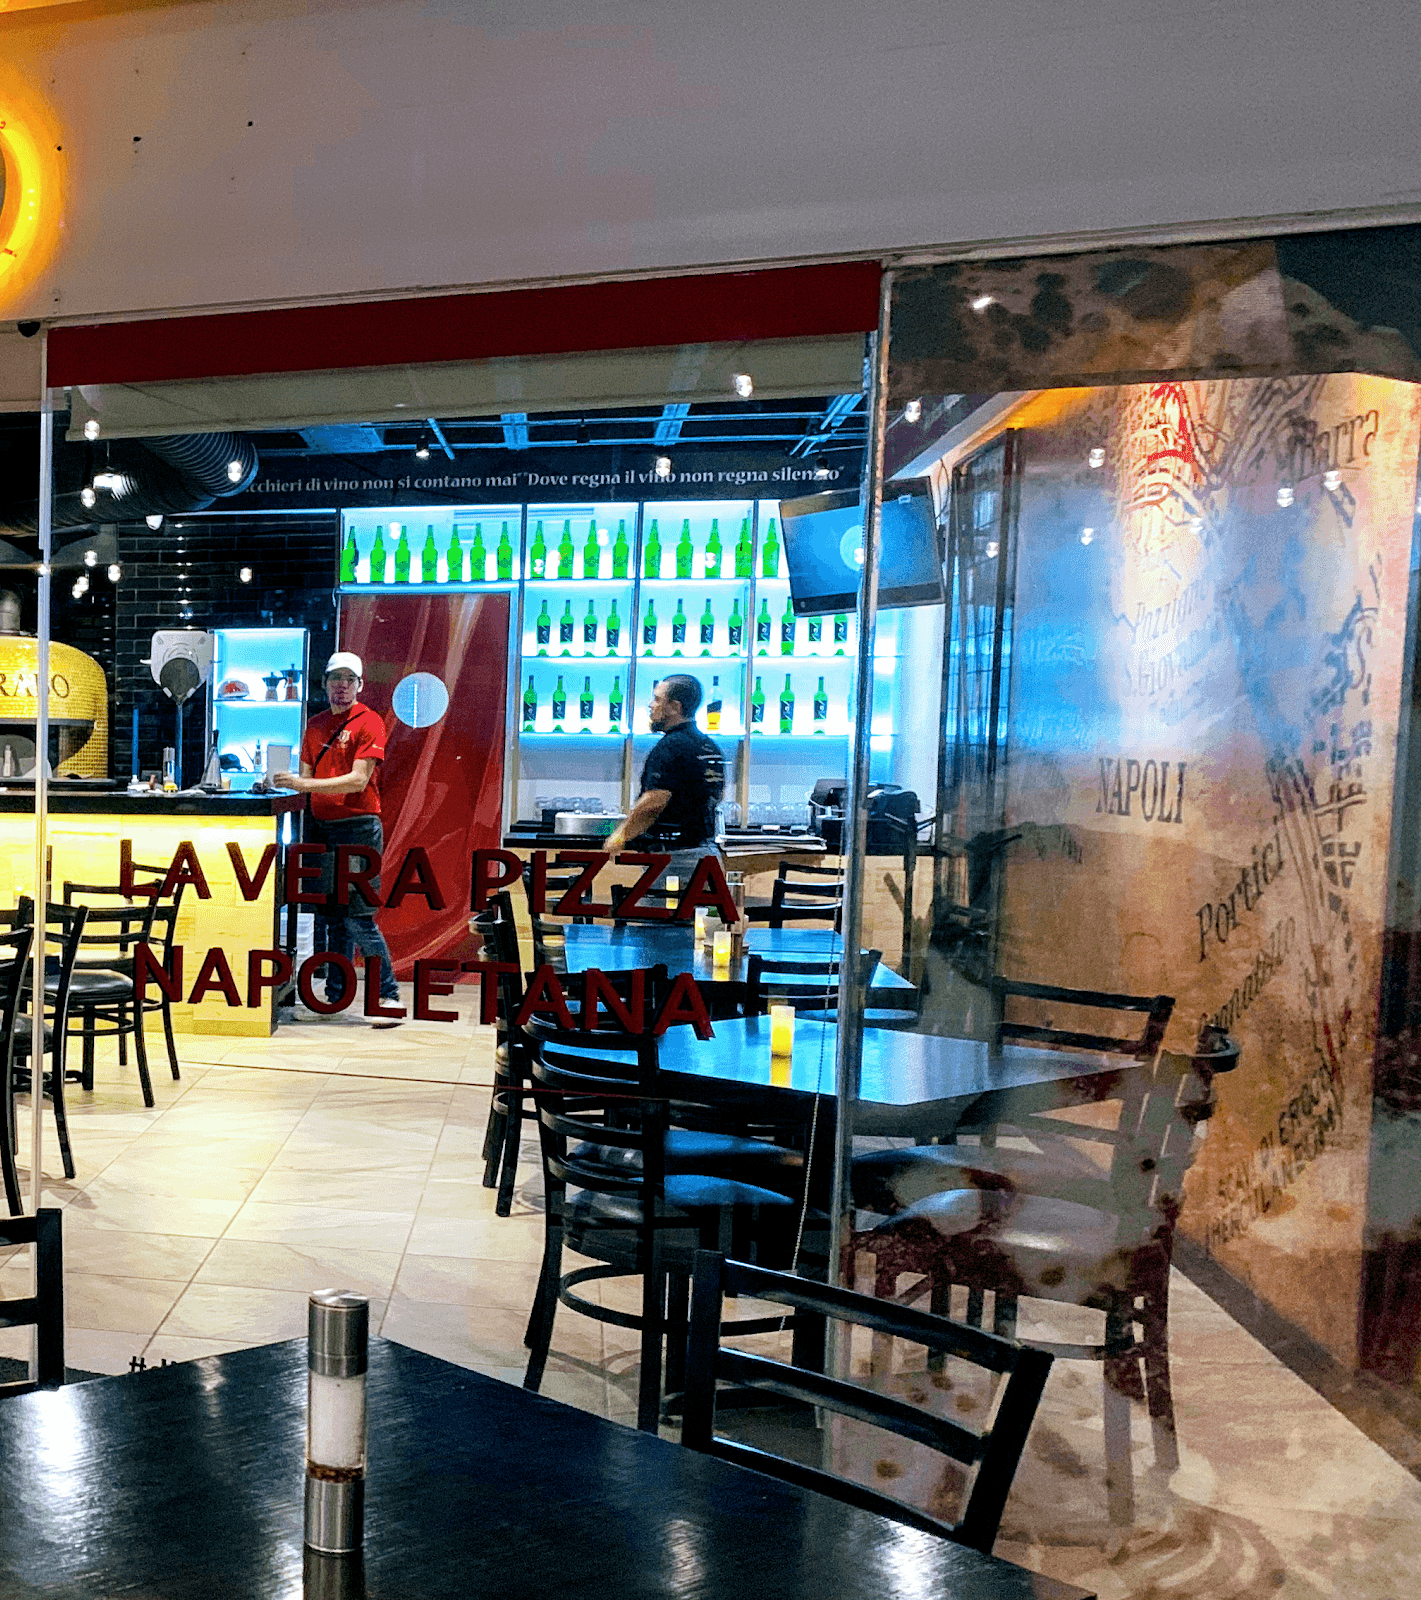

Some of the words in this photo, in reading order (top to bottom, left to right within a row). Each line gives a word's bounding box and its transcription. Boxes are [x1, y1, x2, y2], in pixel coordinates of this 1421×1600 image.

[246, 478, 302, 493] cchieri
[305, 478, 321, 491] di
[324, 477, 360, 491] vino
[363, 478, 395, 490] non
[398, 475, 412, 489] si
[414, 475, 482, 489] contano
[572, 472, 621, 488] regna
[625, 469, 636, 484] il
[680, 472, 714, 483] non
[718, 468, 768, 485] regna
[1096, 758, 1187, 824] NAPOLI
[120, 839, 212, 901] LA
[227, 842, 447, 911] VERA
[470, 847, 740, 924] PIZZA
[133, 943, 716, 1041] NAPOLETANA
